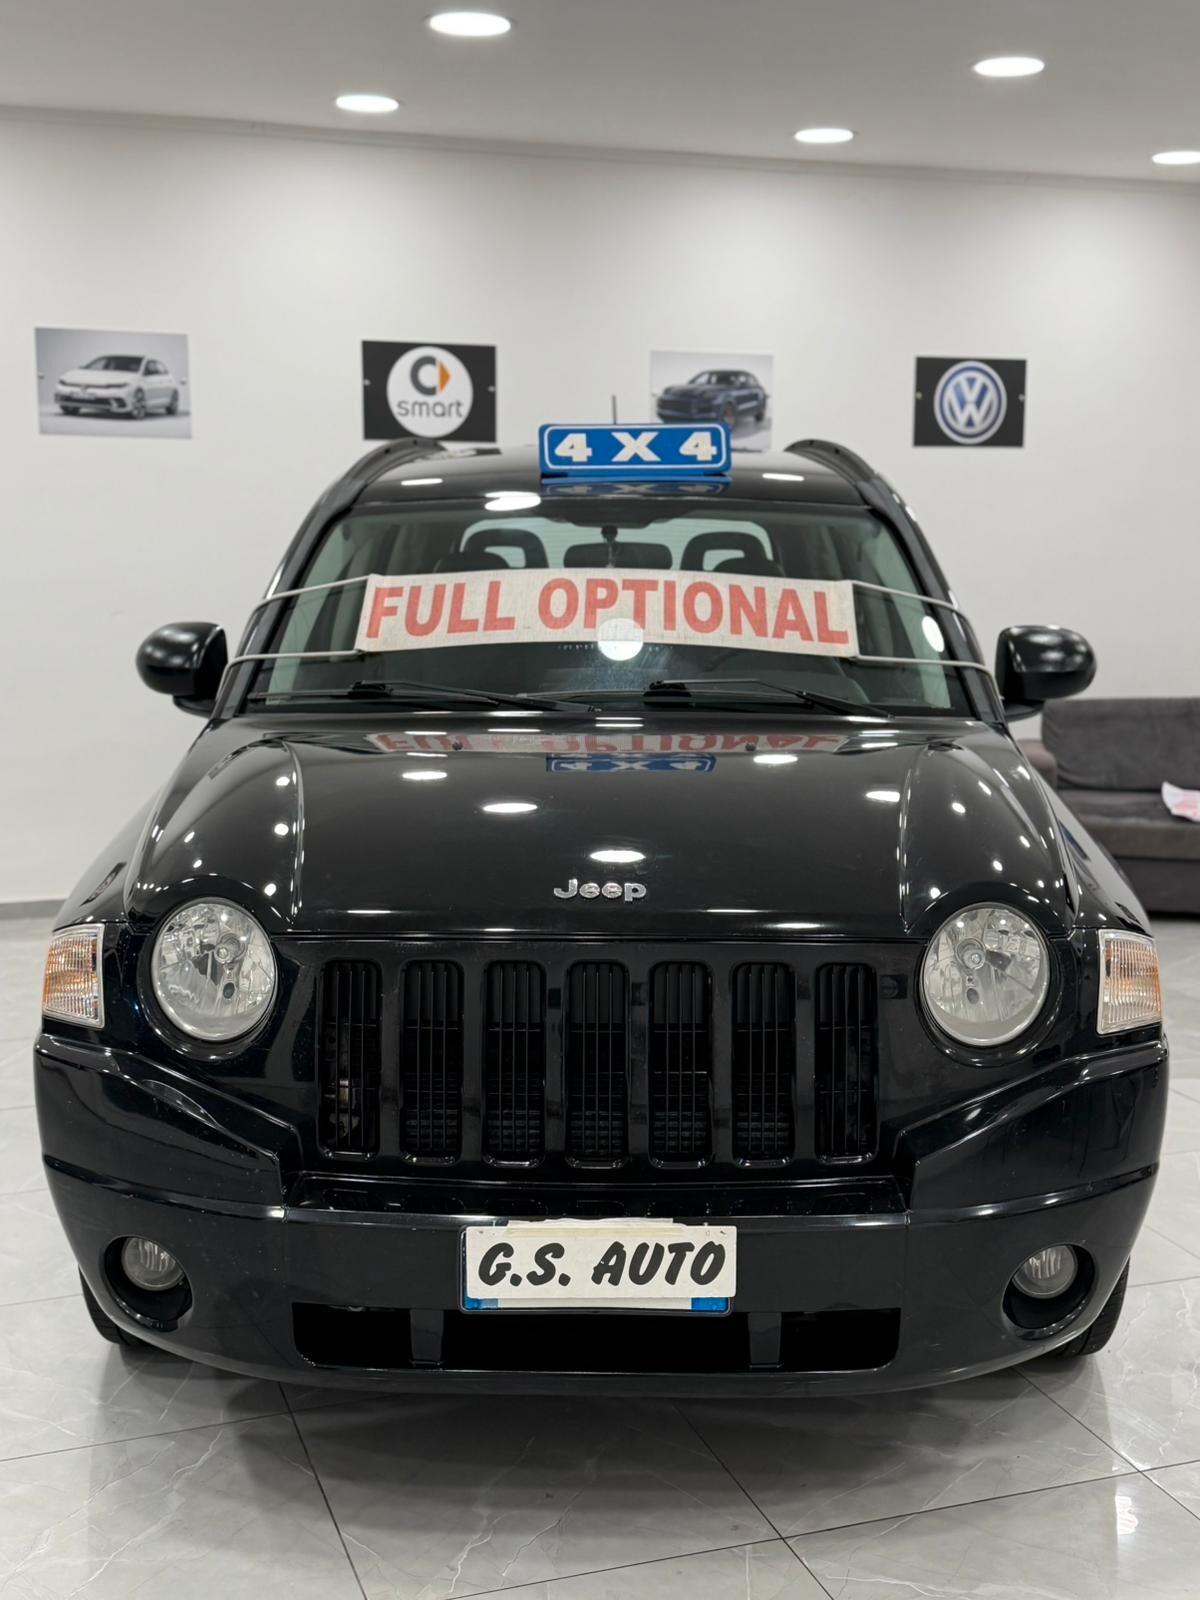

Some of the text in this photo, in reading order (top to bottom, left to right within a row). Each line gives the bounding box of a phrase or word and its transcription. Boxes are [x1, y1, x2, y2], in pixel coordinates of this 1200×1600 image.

[397, 399, 464, 419] smart
[365, 577, 850, 645] FULL OPTIONAL
[553, 878, 647, 902] Jeep
[478, 1240, 726, 1287] G.S. AUTO
